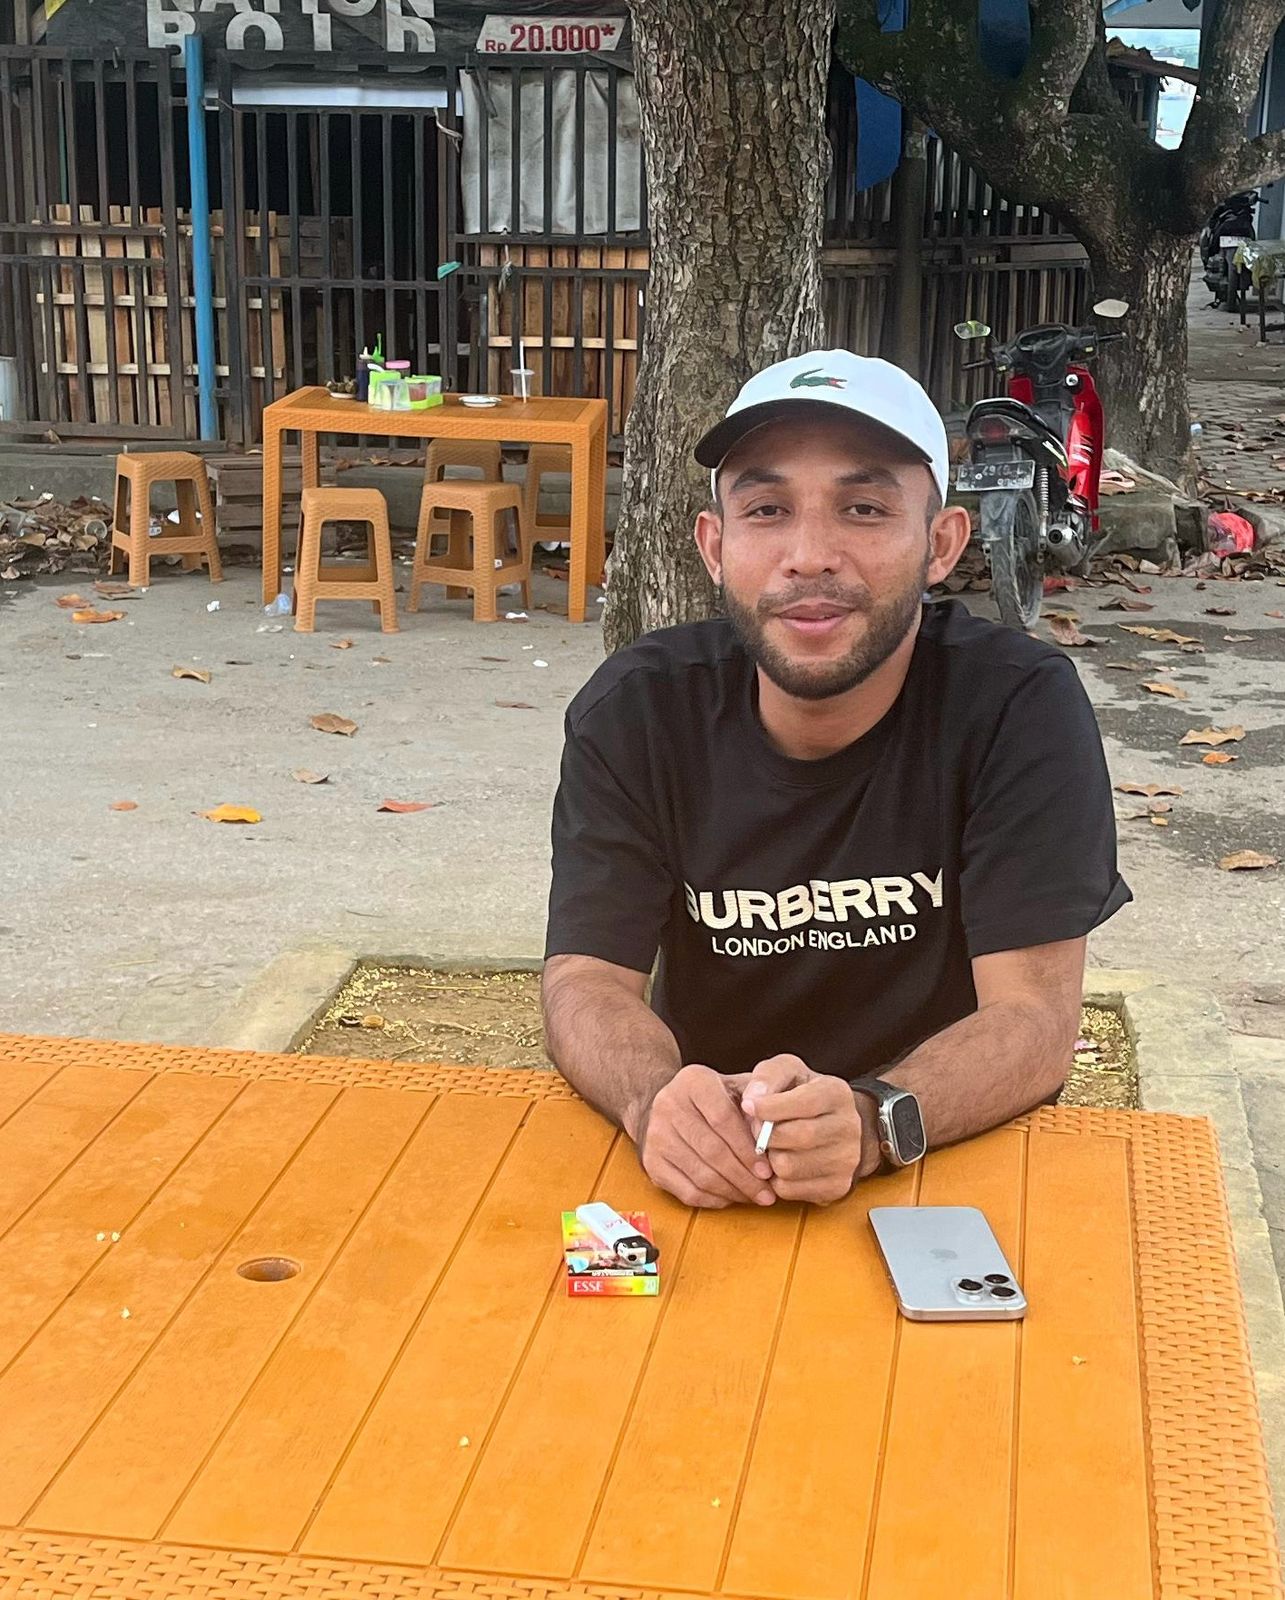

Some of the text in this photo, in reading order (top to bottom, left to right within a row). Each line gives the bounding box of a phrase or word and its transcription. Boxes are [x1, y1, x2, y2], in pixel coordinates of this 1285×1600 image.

[485, 39, 507, 53] Rp
[712, 923, 917, 957] LONDON ENGLAND
[573, 1281, 604, 1293] ESSE
